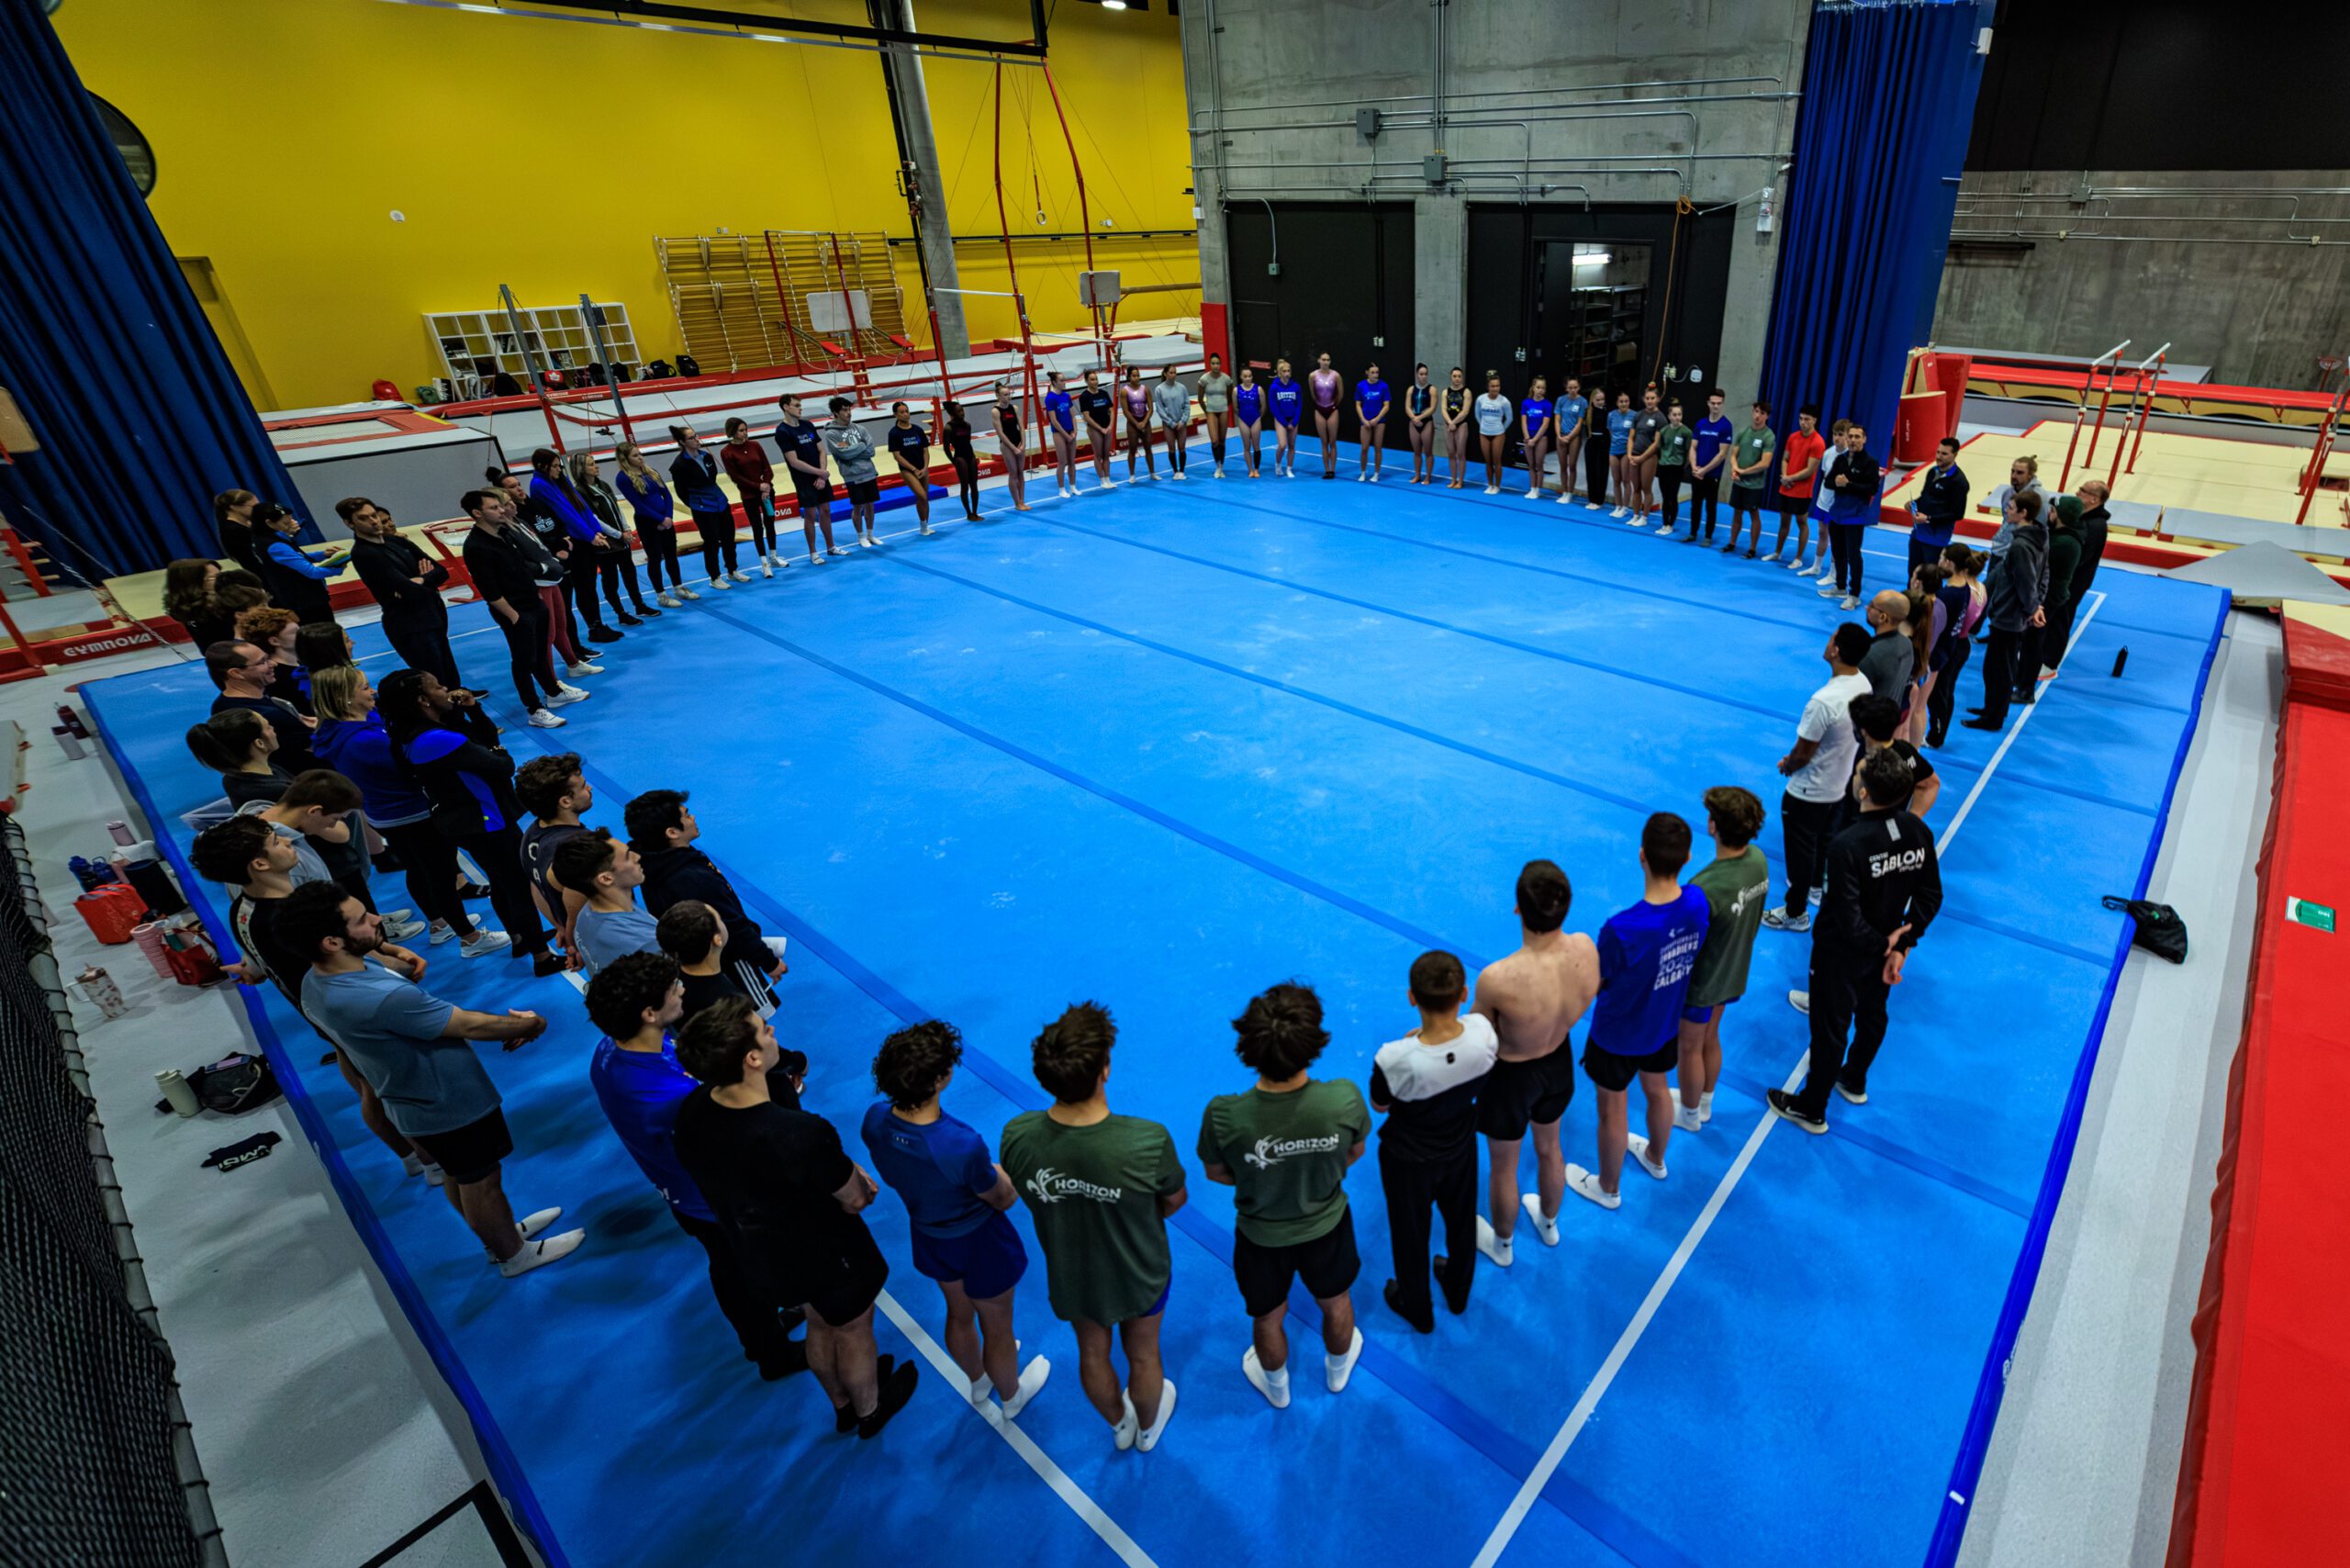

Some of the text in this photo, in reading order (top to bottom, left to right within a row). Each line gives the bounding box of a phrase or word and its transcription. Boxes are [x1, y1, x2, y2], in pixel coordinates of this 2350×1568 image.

[63, 633, 152, 656] GYMNOVA
[1871, 846, 1925, 879] SABLON
[1273, 1134, 1339, 1154] HORIZON
[1054, 1178, 1122, 1199] HORIZON
